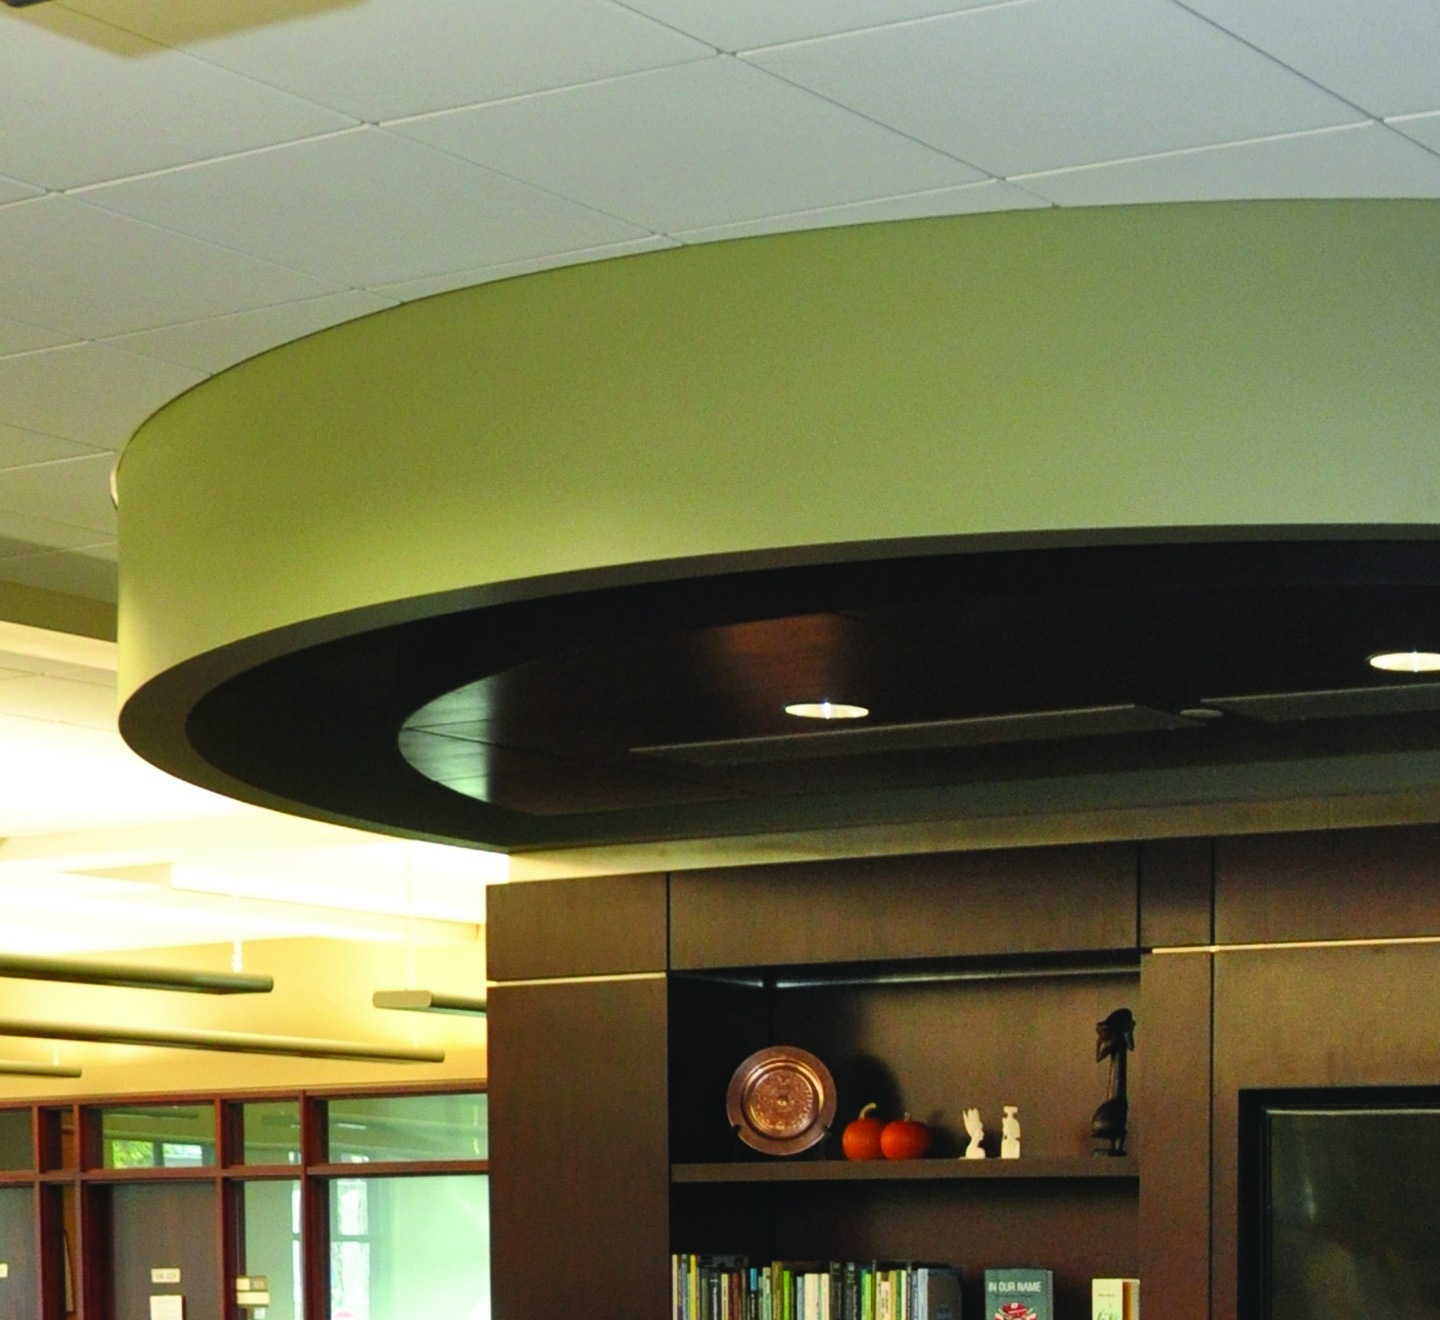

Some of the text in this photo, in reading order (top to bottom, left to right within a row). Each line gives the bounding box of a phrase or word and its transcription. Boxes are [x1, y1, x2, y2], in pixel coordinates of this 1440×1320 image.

[988, 1281, 1042, 1293] IN OUR NAME
